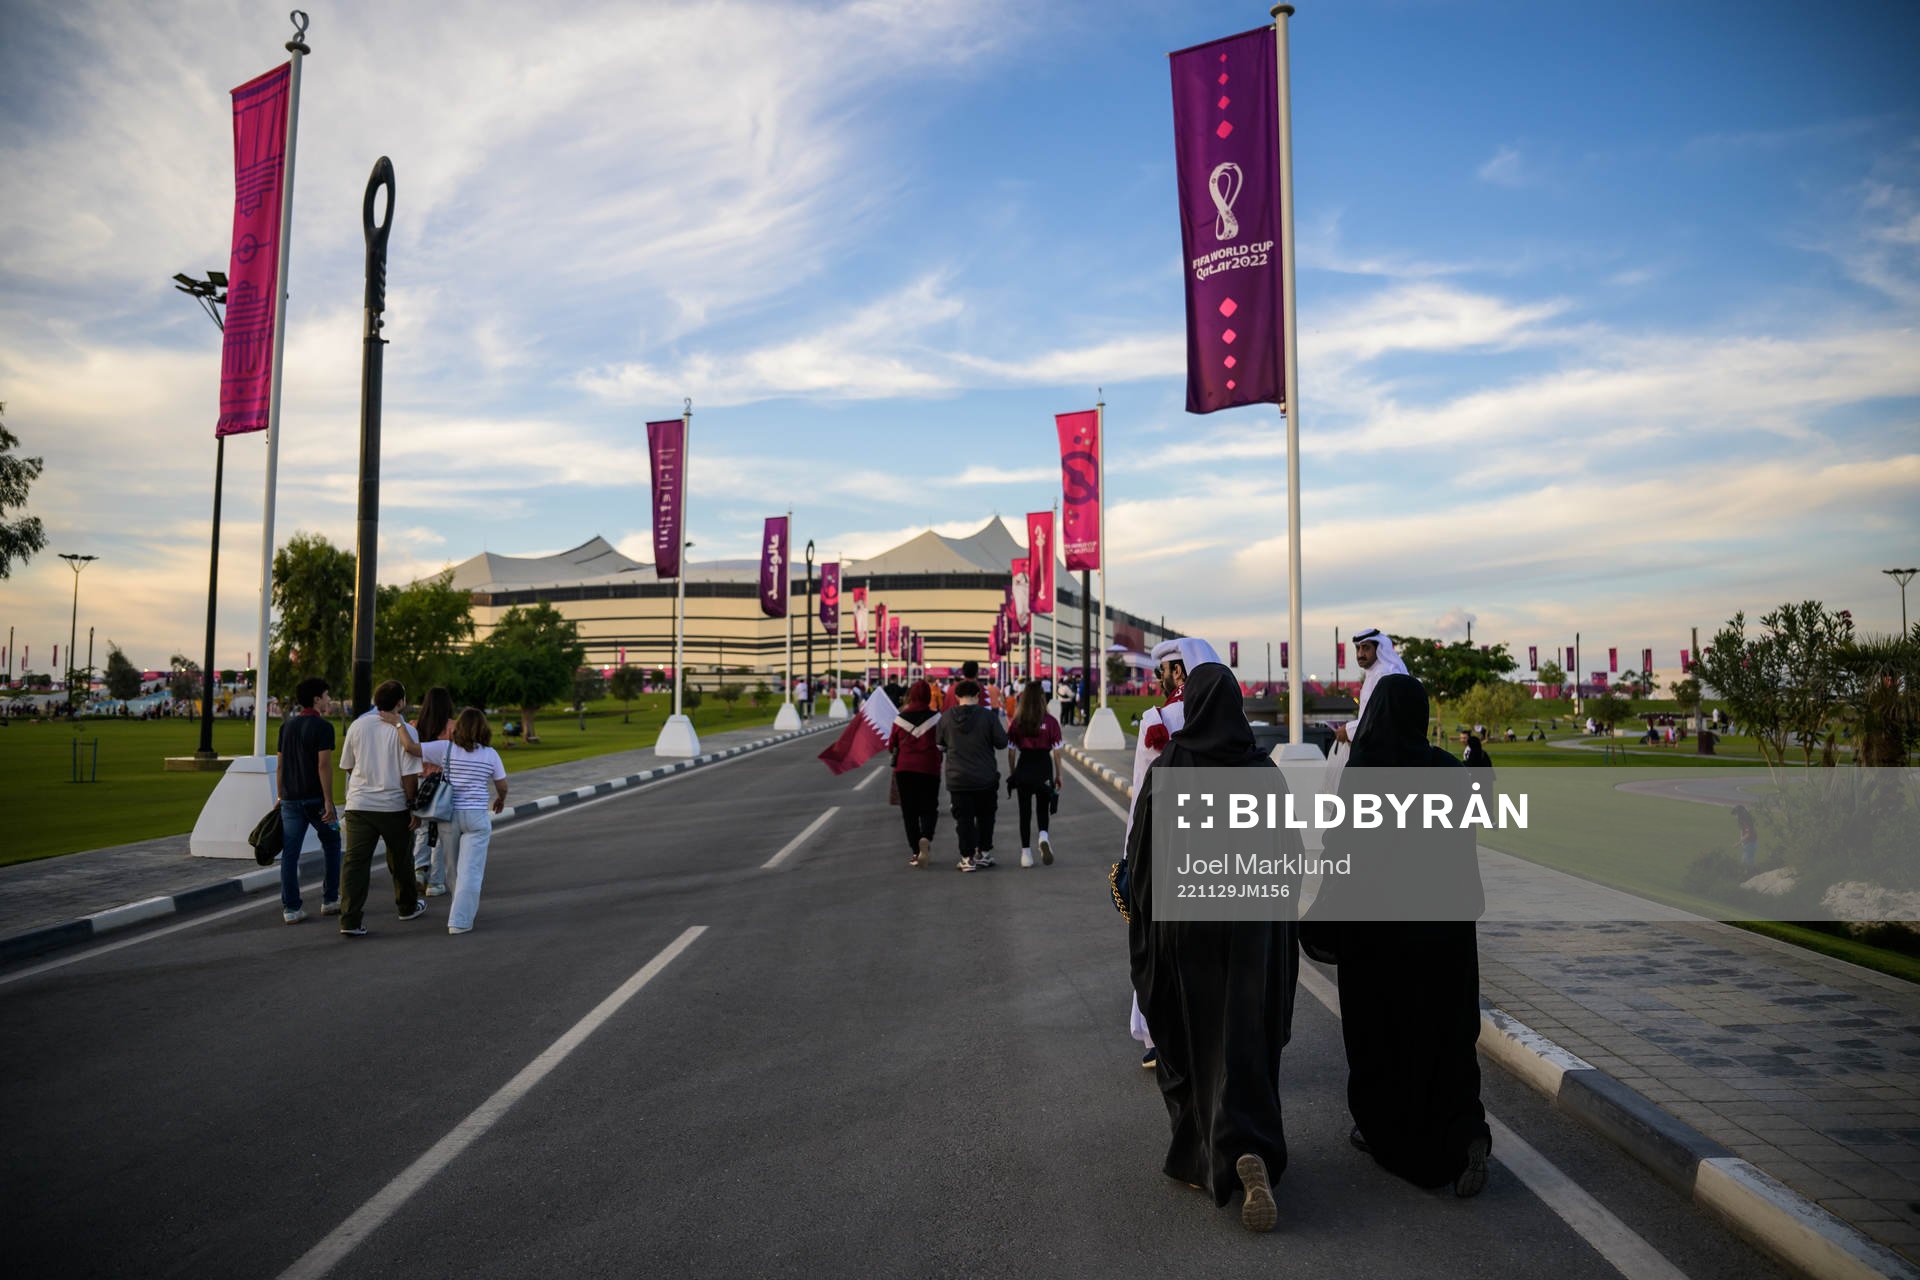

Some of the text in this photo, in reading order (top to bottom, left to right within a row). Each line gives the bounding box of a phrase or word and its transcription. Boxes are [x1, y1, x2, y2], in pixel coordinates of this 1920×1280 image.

[1192, 240, 1274, 269] FIFA WORLD CUP
